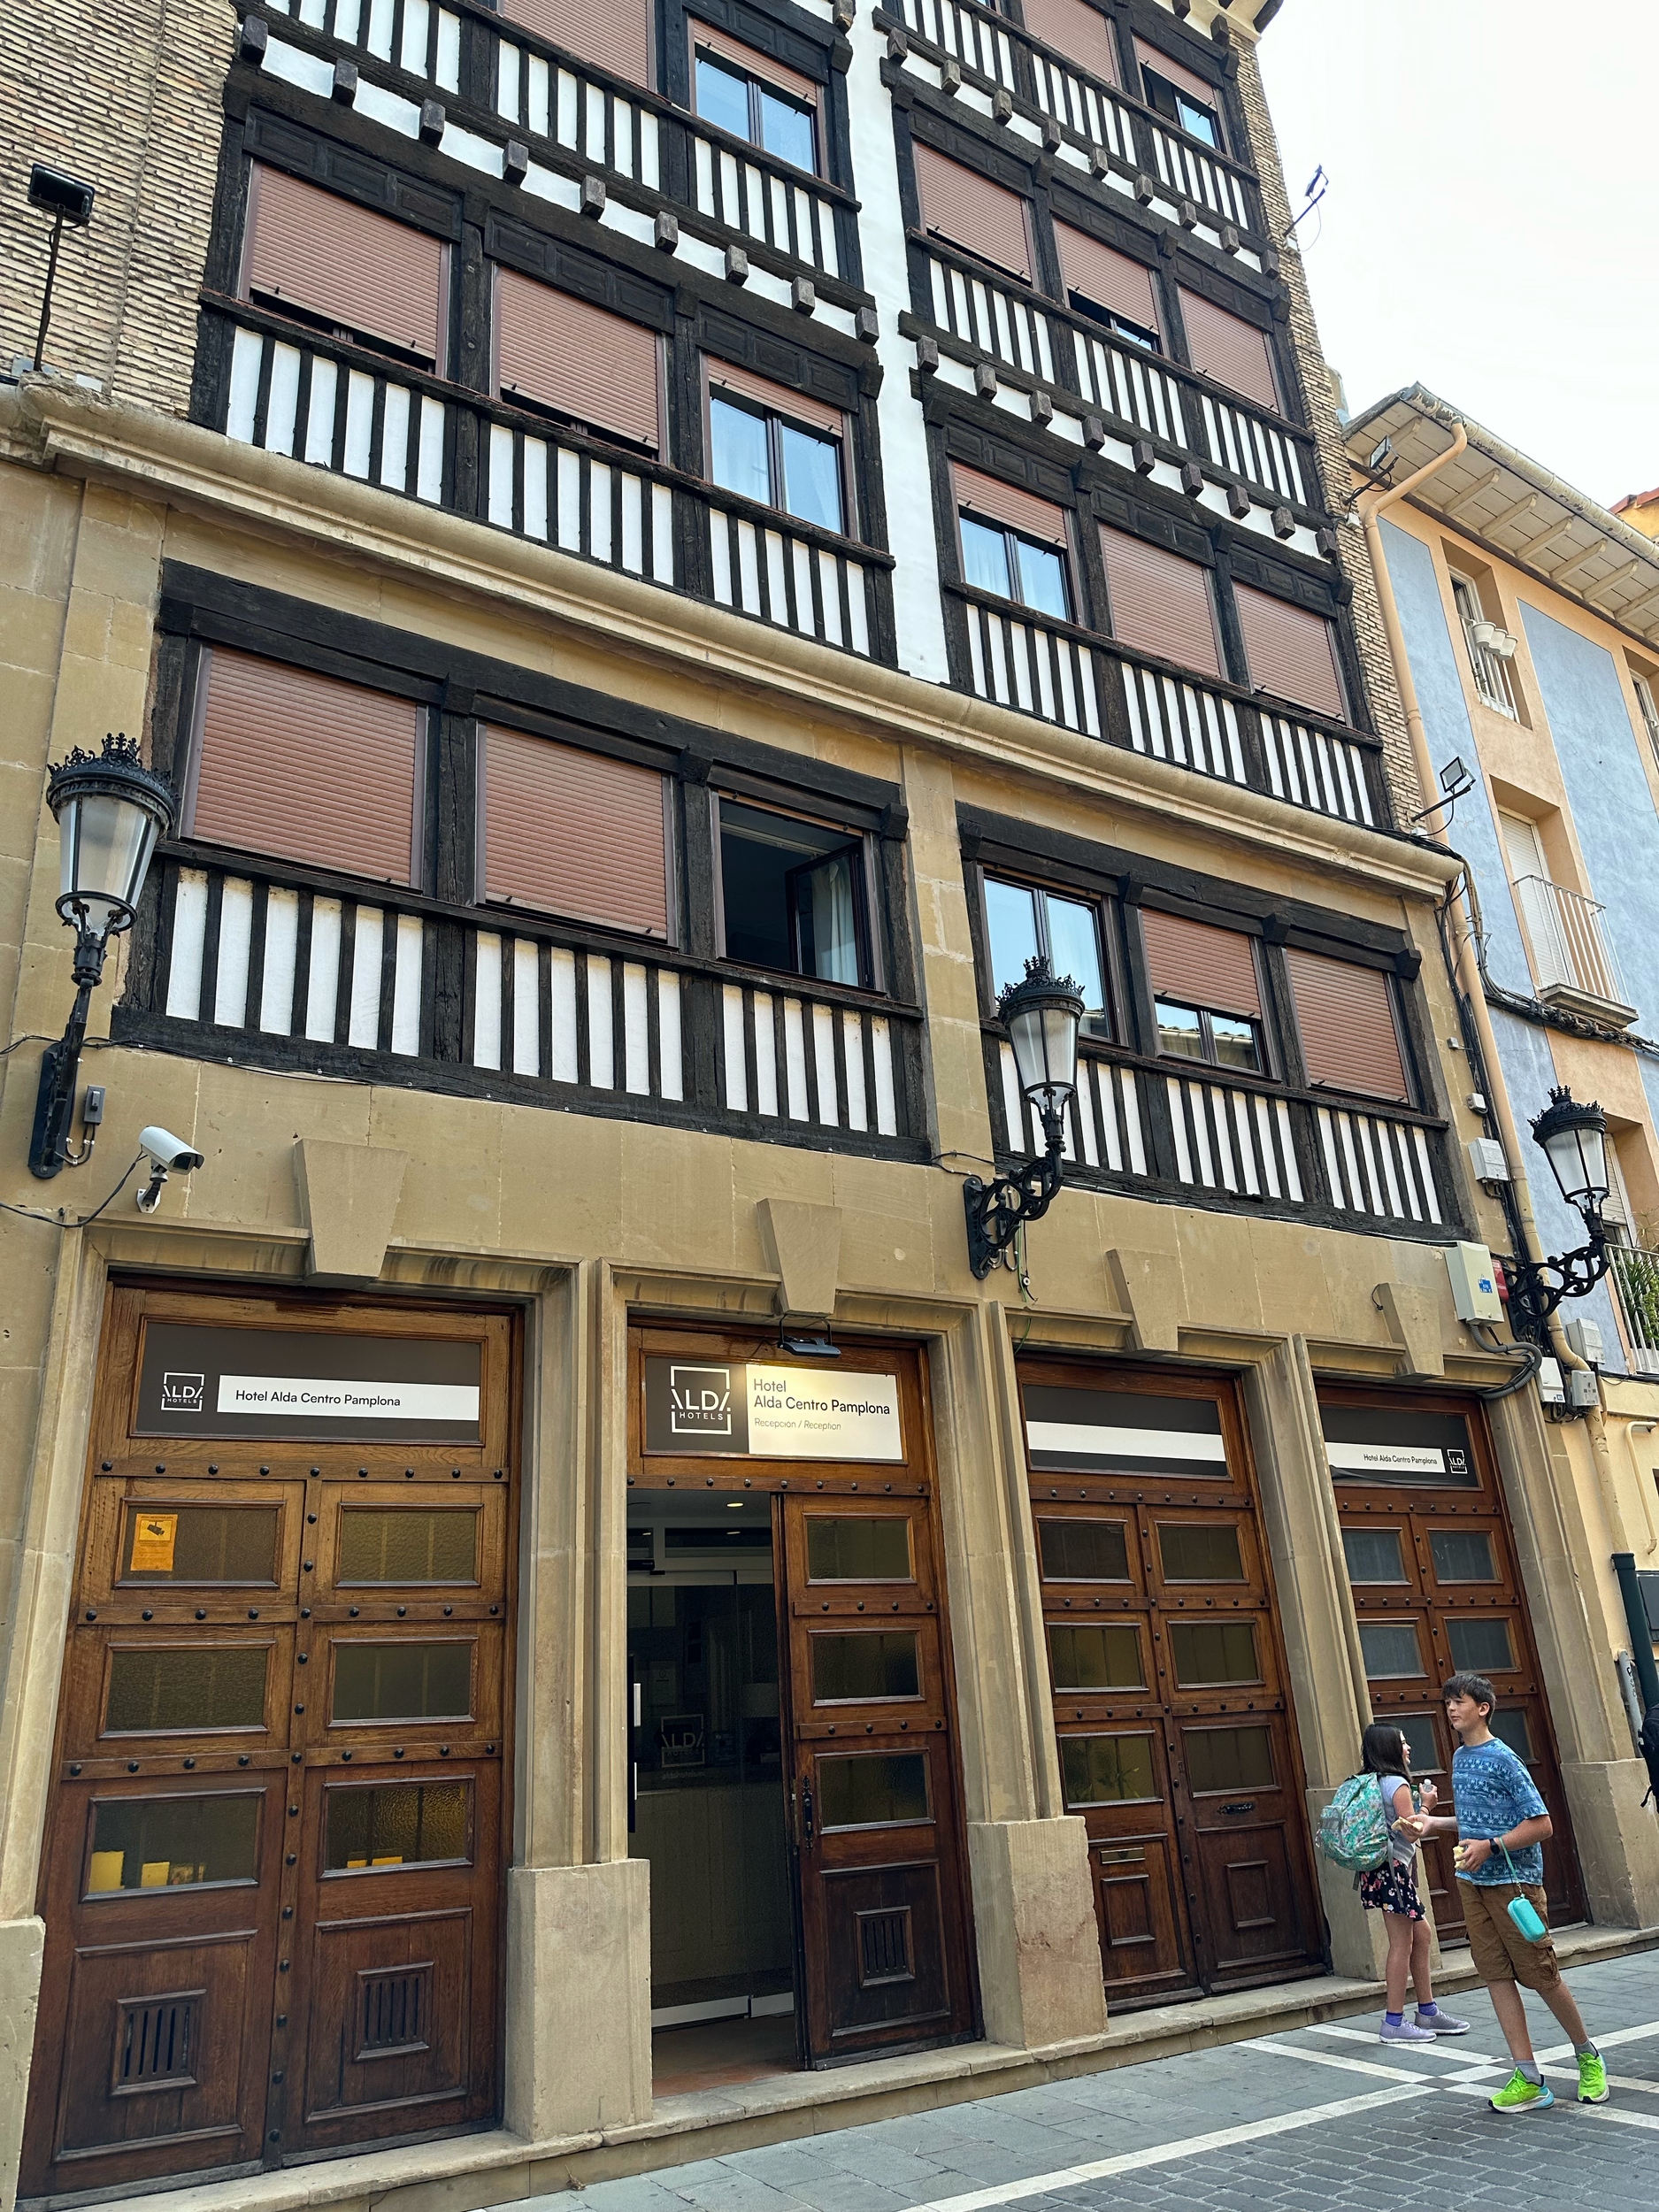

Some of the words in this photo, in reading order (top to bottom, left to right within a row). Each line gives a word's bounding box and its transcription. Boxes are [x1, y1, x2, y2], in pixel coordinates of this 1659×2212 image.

[754, 1379, 787, 1393] Hotel
[235, 1390, 268, 1402] Hotel
[271, 1391, 297, 1402] Alda
[301, 1393, 342, 1404] Centro
[344, 1394, 401, 1408] Pamplona
[754, 1395, 782, 1409] Alda
[786, 1396, 828, 1411] Centro
[831, 1399, 890, 1417] Pamplona
[680, 1411, 724, 1421] HOTELS
[754, 1417, 796, 1430] Recepción
[797, 1420, 803, 1429] /
[803, 1420, 841, 1432] Reception
[1392, 1455, 1411, 1463] Centro
[1411, 1456, 1438, 1465] Pamplona
